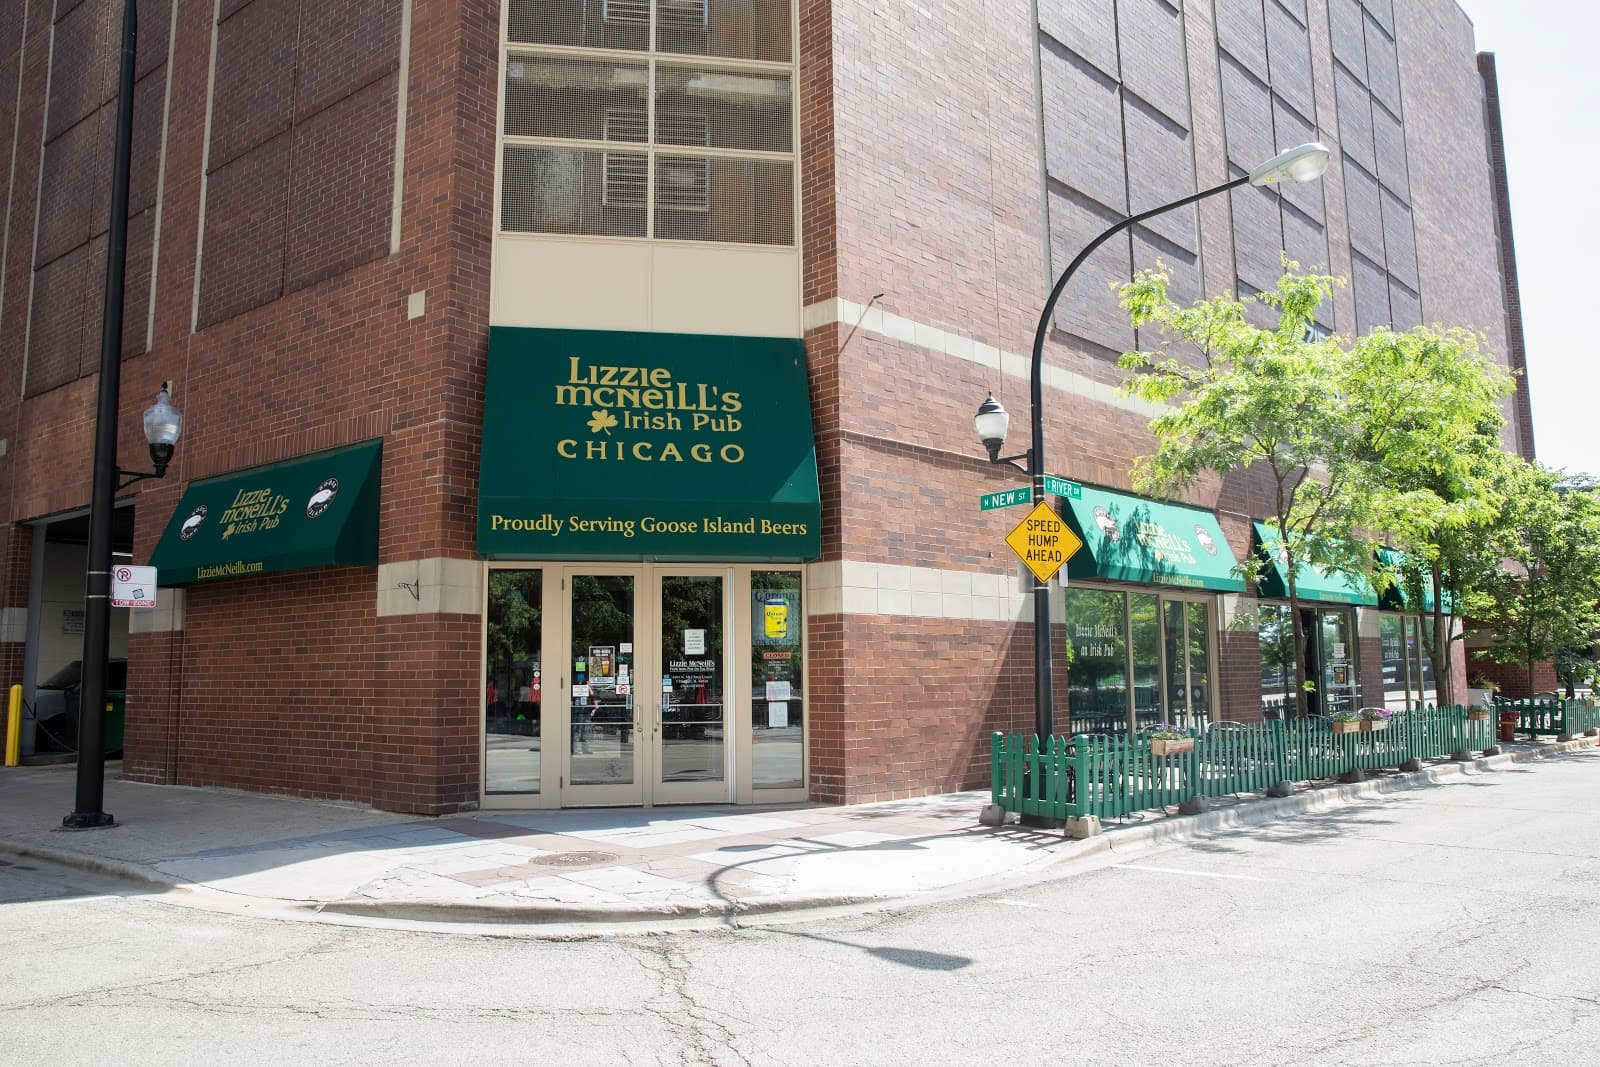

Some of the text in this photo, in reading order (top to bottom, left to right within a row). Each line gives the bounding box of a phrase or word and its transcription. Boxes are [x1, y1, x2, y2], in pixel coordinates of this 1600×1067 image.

[623, 411, 743, 432] Irish Pub
[556, 439, 745, 463] CHICAGO
[1051, 479, 1072, 496] RIVER
[984, 492, 1026, 508] N NEW ST
[235, 515, 280, 534] Irish Pub
[491, 515, 807, 537] Proudly Serving Goose Island Beers
[1027, 520, 1061, 533] SPEED
[1028, 535, 1059, 547] HUMP
[1026, 549, 1062, 562] AHEAD
[1090, 641, 1103, 657] Irish
[1104, 642, 1114, 657] Pub
